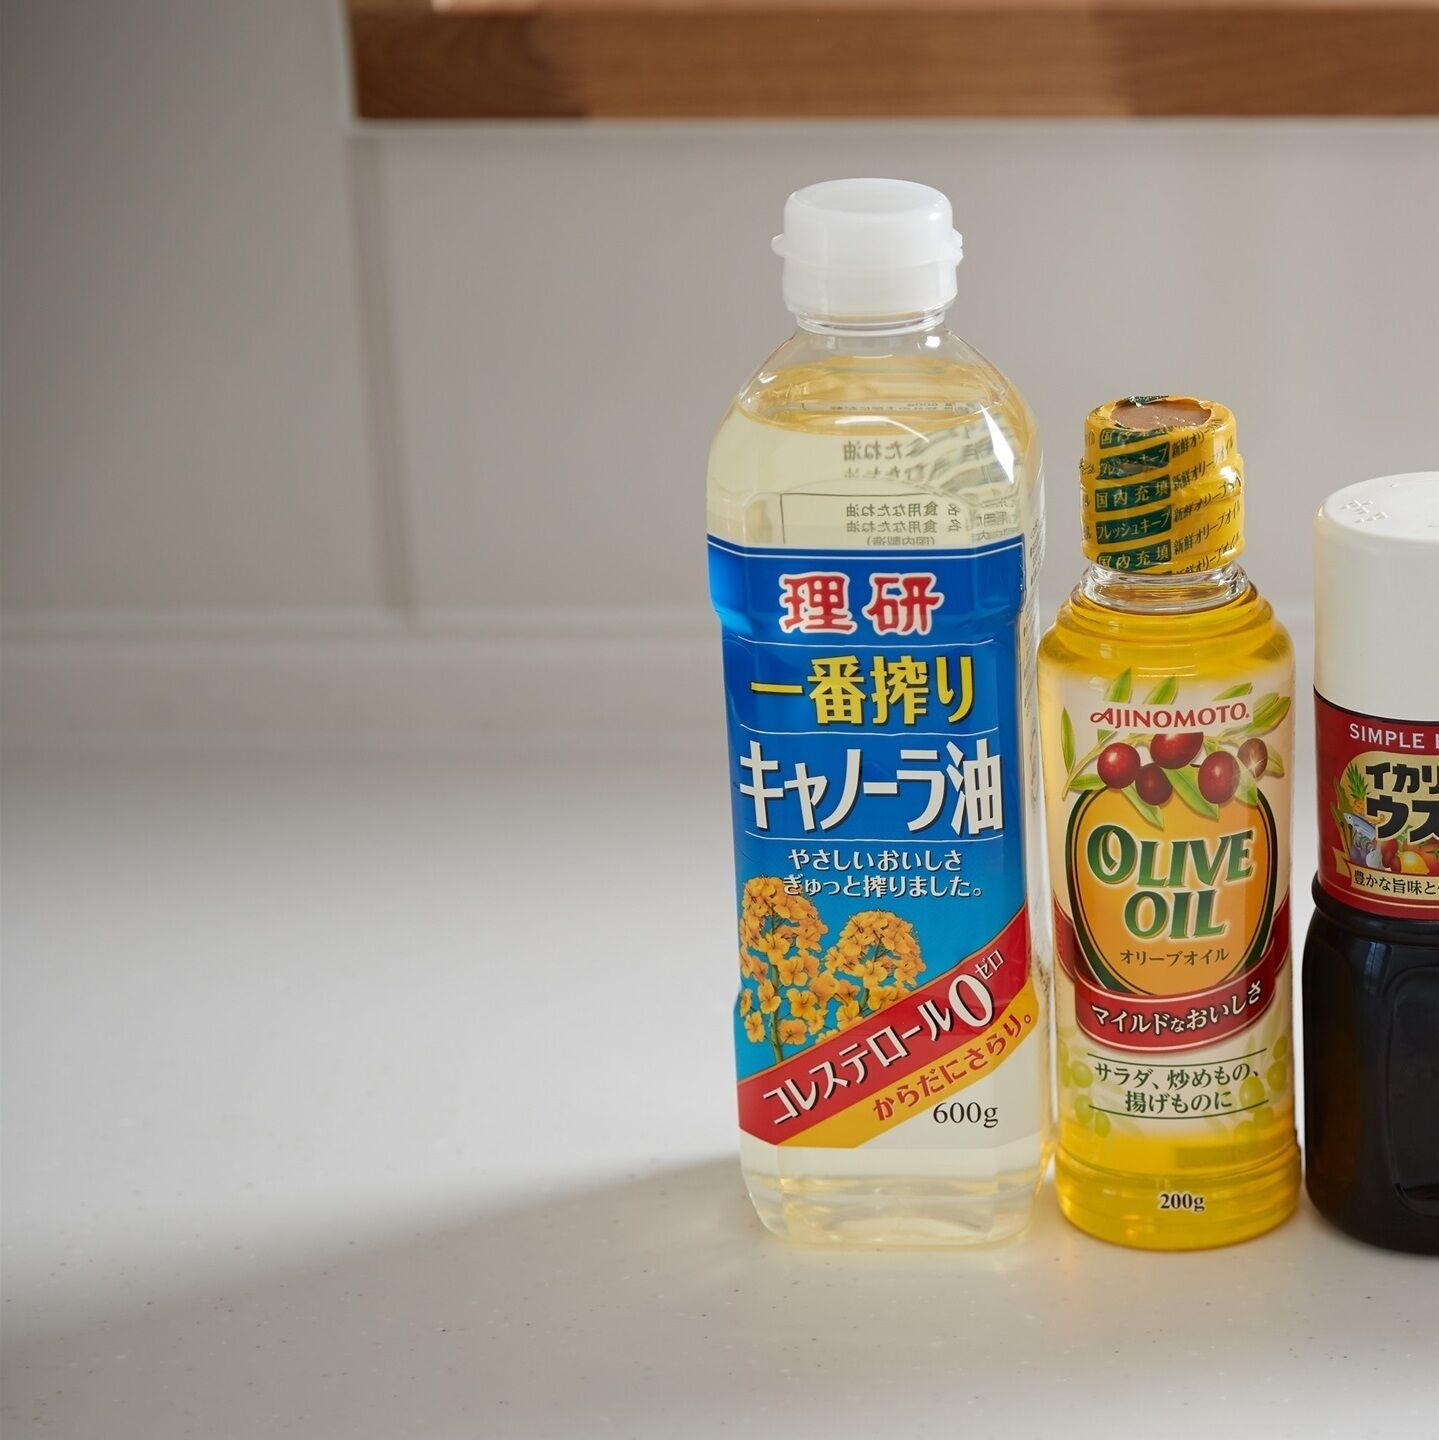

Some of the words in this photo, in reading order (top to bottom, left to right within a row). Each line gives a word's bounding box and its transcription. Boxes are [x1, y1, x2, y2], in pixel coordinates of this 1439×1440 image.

[1097, 481, 1169, 510] 国内充填
[778, 571, 945, 636] 理研
[750, 654, 975, 726] 一番搾り
[1349, 722, 1425, 749] SIMPLE
[739, 737, 1004, 836] キャノーラ油
[787, 848, 963, 872] やさしいおいしさ
[1087, 824, 1255, 887] OLIVE
[782, 873, 983, 898] ぎゅっと搾りました。
[1124, 889, 1227, 940] OIL
[974, 949, 1004, 981] ゼロ
[1120, 947, 1230, 967] オリーブオイル
[1090, 979, 1261, 1036] マイルドなおいしさ
[873, 1014, 1032, 1122] からだにさらり。
[1094, 1063, 1260, 1091] サラダ、炒めもの、
[932, 1101, 999, 1129] 600g
[1124, 1090, 1233, 1114] 揚げものに
[1159, 1192, 1206, 1213] 200g
